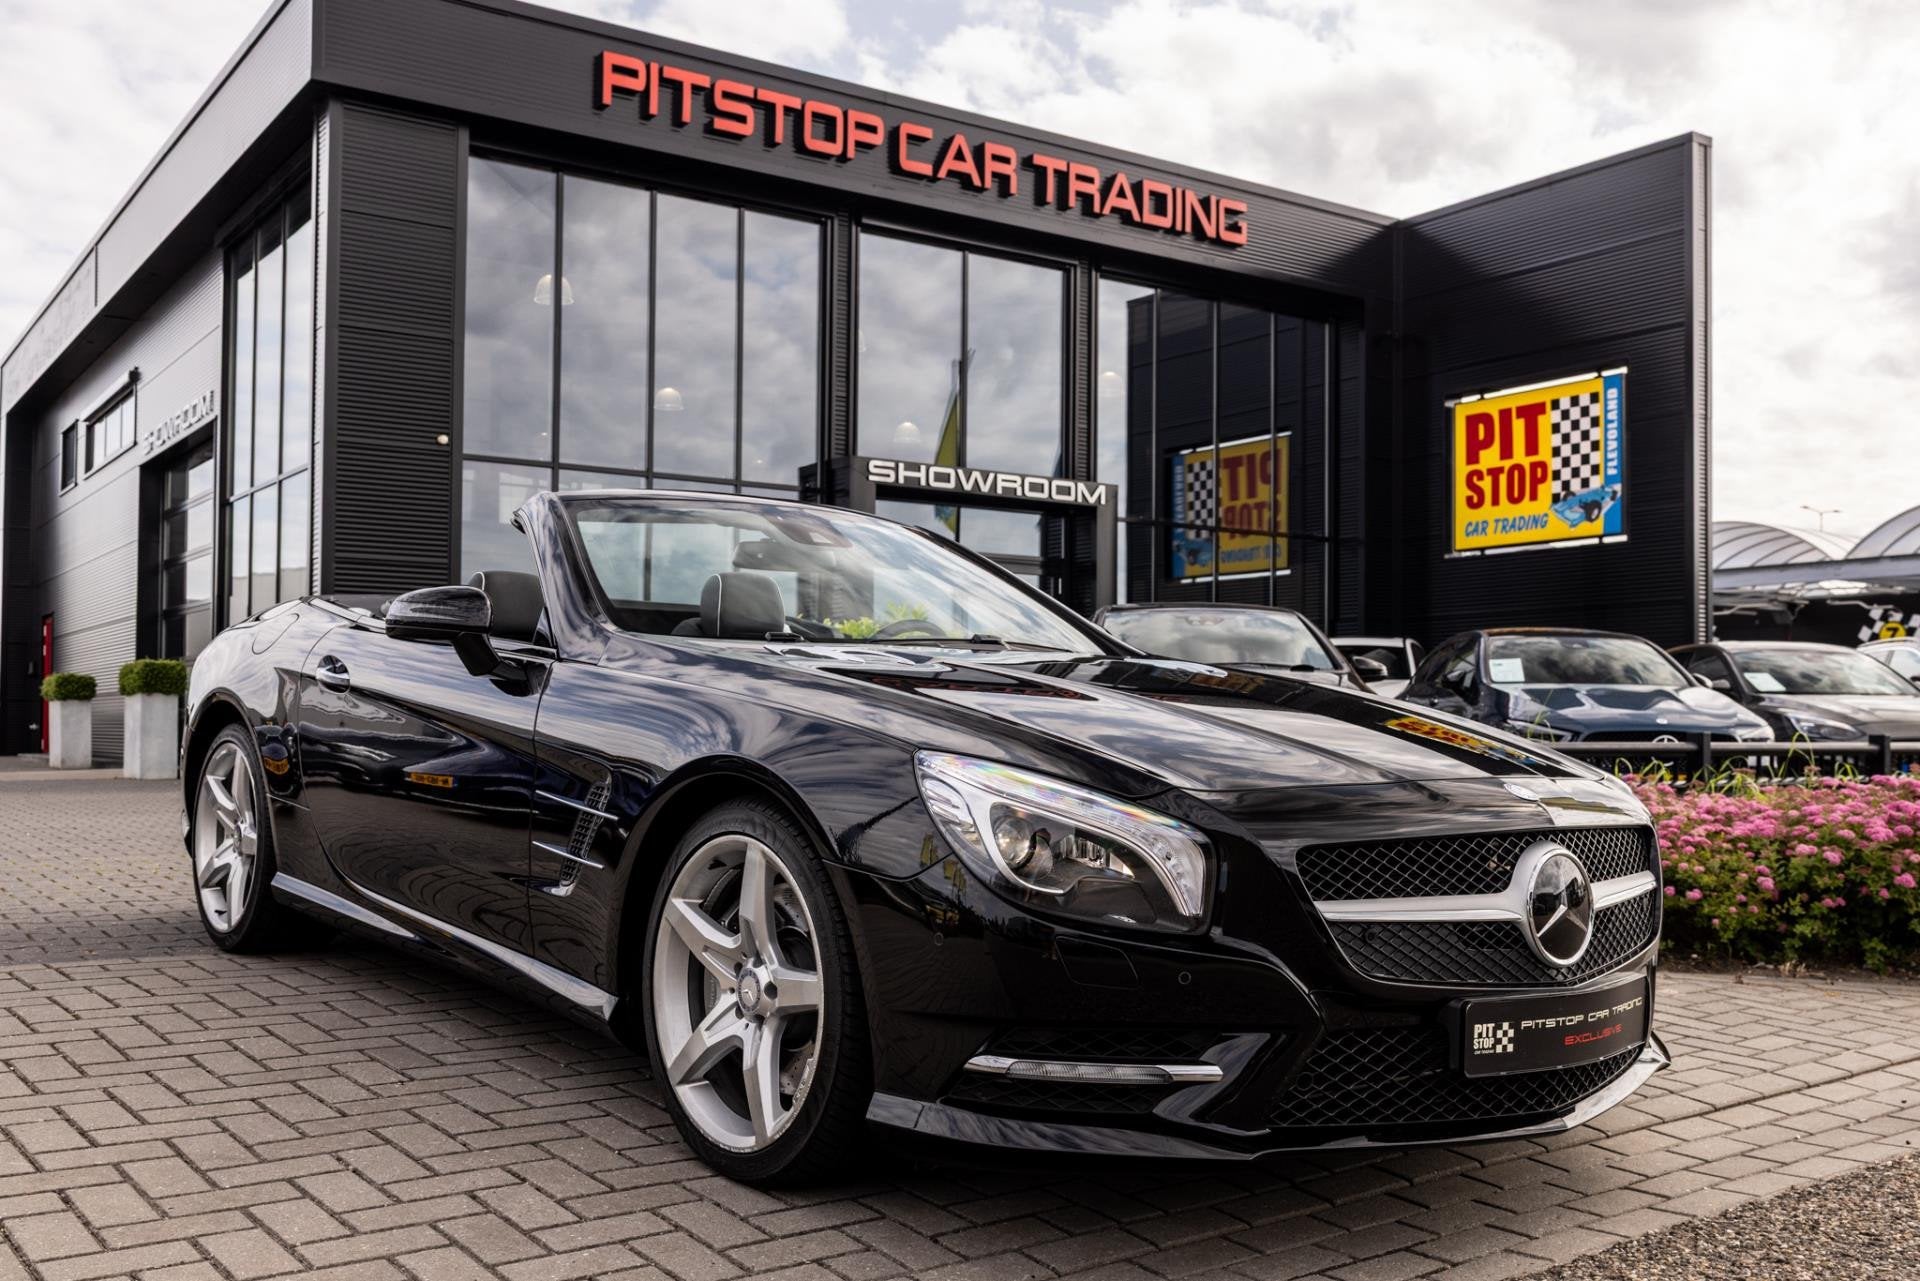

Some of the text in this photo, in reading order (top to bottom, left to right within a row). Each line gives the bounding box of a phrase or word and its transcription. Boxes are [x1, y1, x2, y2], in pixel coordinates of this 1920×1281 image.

[602, 50, 1248, 245] PITSTOP CAR TRADING
[1465, 401, 1547, 466] PIT
[1607, 387, 1619, 476] FLEVOLAND
[868, 459, 1107, 505] SHOWROOM
[1465, 460, 1549, 510] STOP
[1464, 512, 1549, 538] CAR TRADING
[1473, 1022, 1496, 1039] PIT
[1520, 1013, 1585, 1030] PITSTOP
[1587, 1008, 1610, 1022] CAR
[1564, 1023, 1624, 1046] EXCLUSIVE
[1473, 1037, 1496, 1050] STOP
